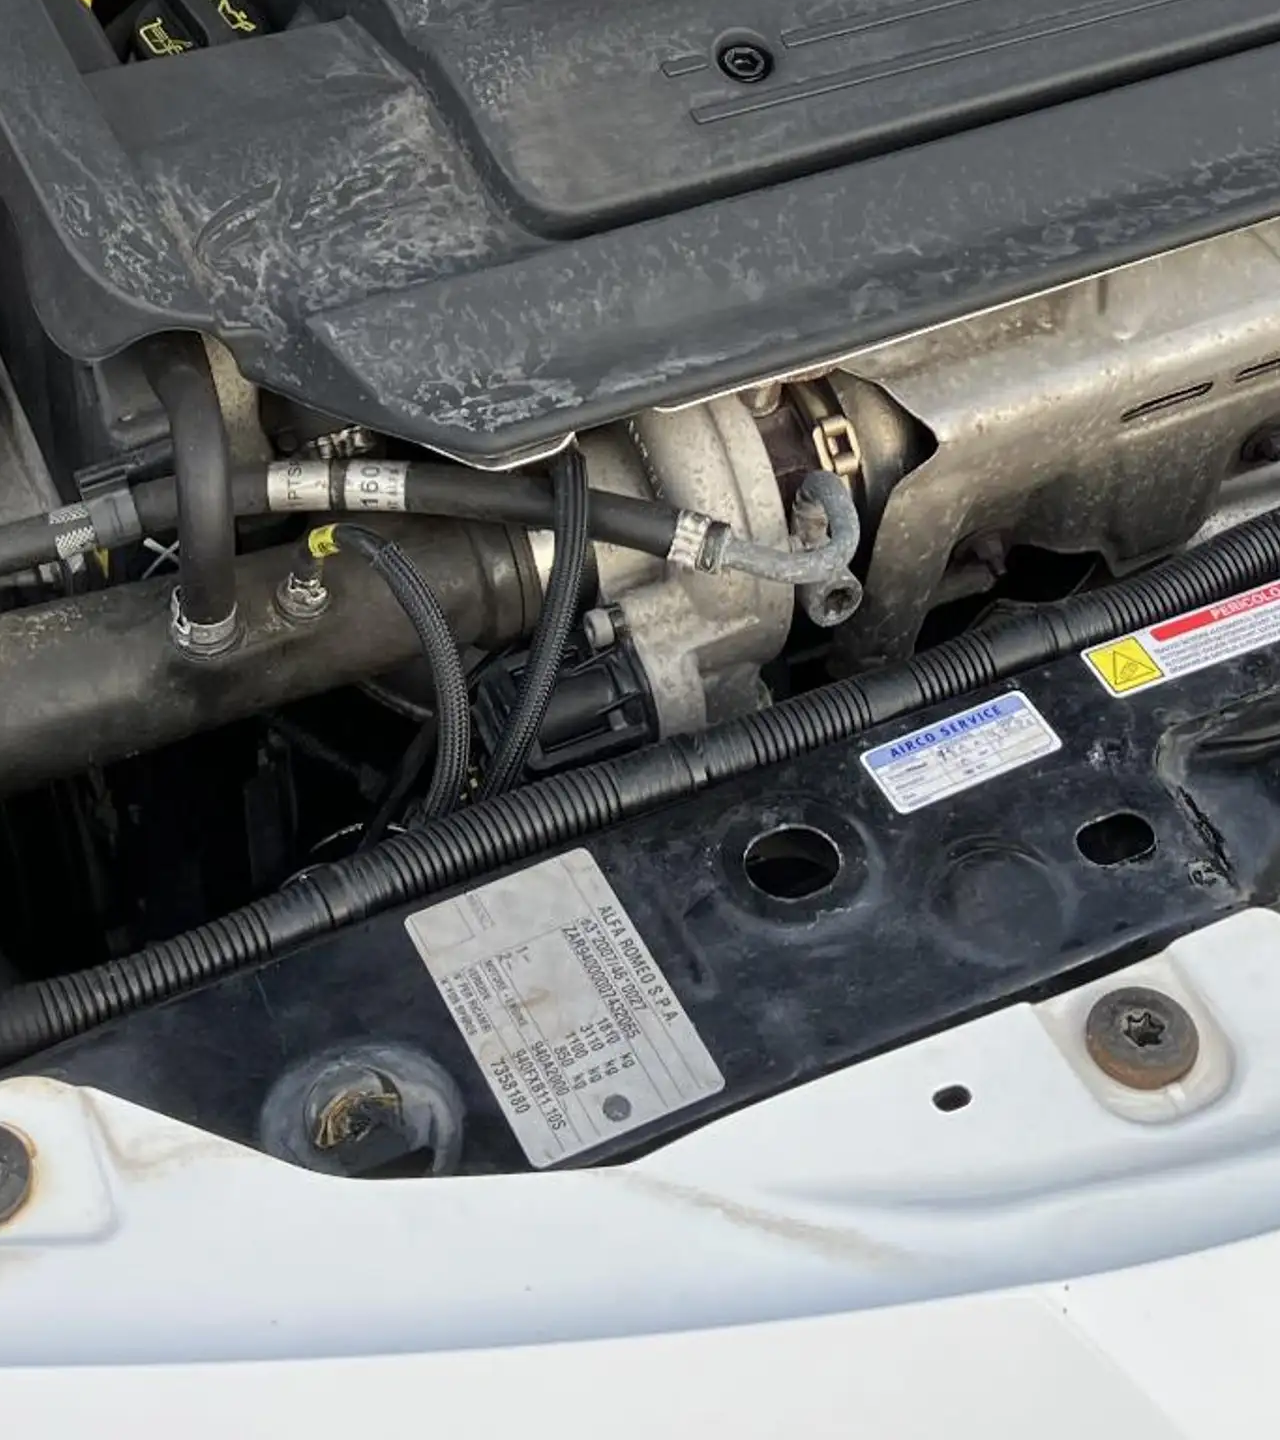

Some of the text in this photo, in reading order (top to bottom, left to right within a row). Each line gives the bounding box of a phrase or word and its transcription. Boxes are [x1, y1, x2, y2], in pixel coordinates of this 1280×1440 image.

[888, 726, 938, 760] AIRCO
[940, 702, 1005, 741] SERVICE
[597, 905, 627, 939] ALFA
[617, 937, 657, 984] ROMEO
[579, 1022, 606, 1052] 3110
